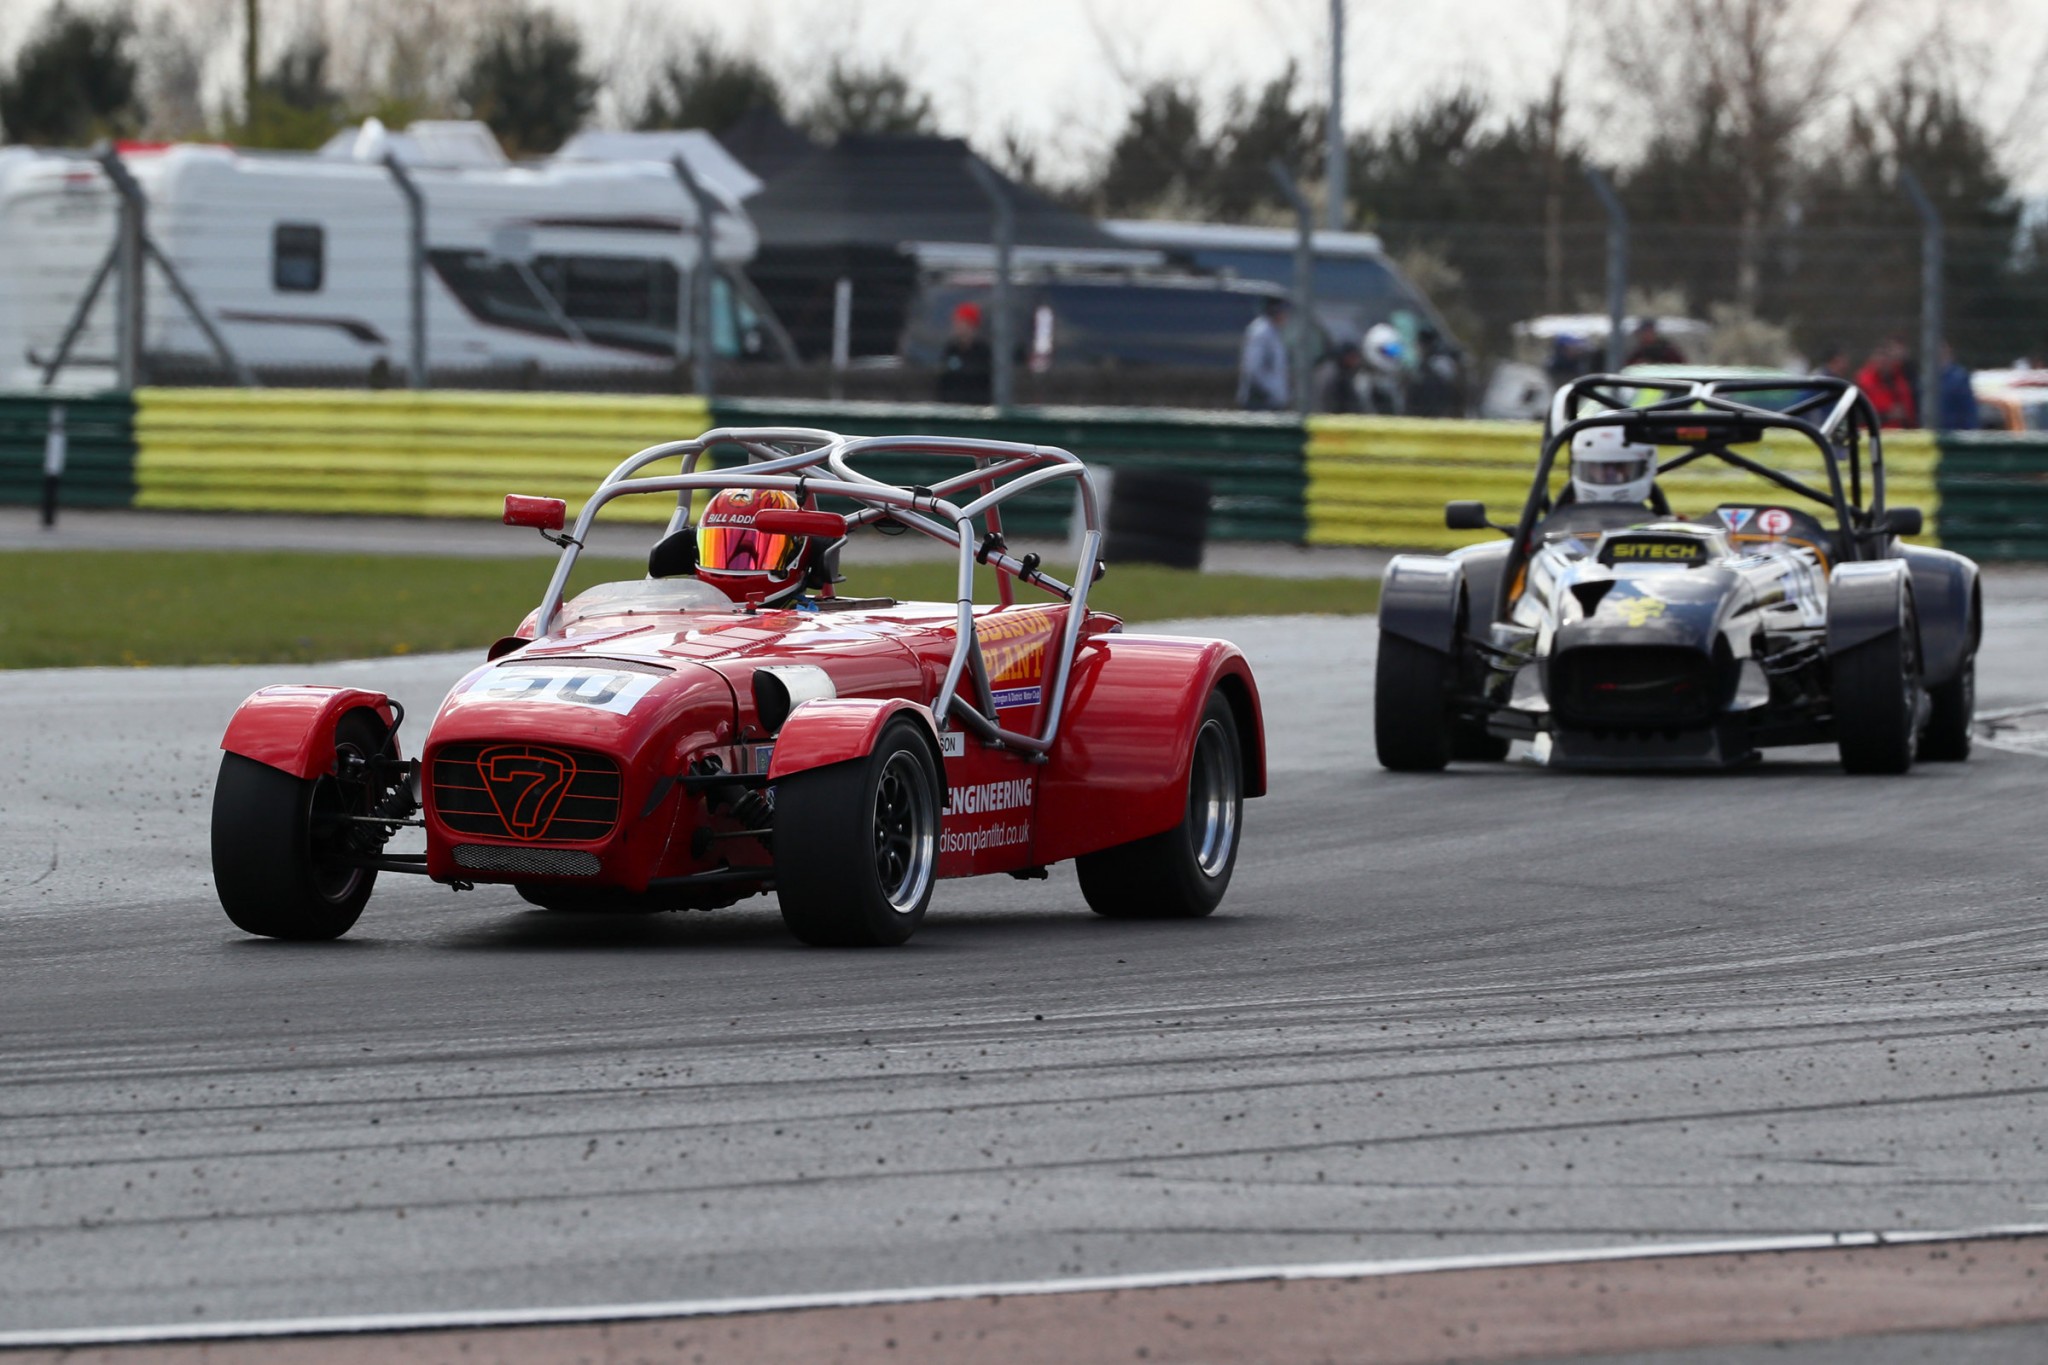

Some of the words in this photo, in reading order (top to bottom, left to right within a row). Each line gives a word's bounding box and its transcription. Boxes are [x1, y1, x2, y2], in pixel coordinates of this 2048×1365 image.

[706, 513, 728, 523] BILL
[1612, 543, 1697, 559] SITECH
[980, 640, 1044, 683] PLANT
[486, 668, 635, 705] 50
[940, 736, 956, 752] SON
[491, 755, 564, 827] 7
[939, 819, 1031, 857] disonplantltd.co.uk
